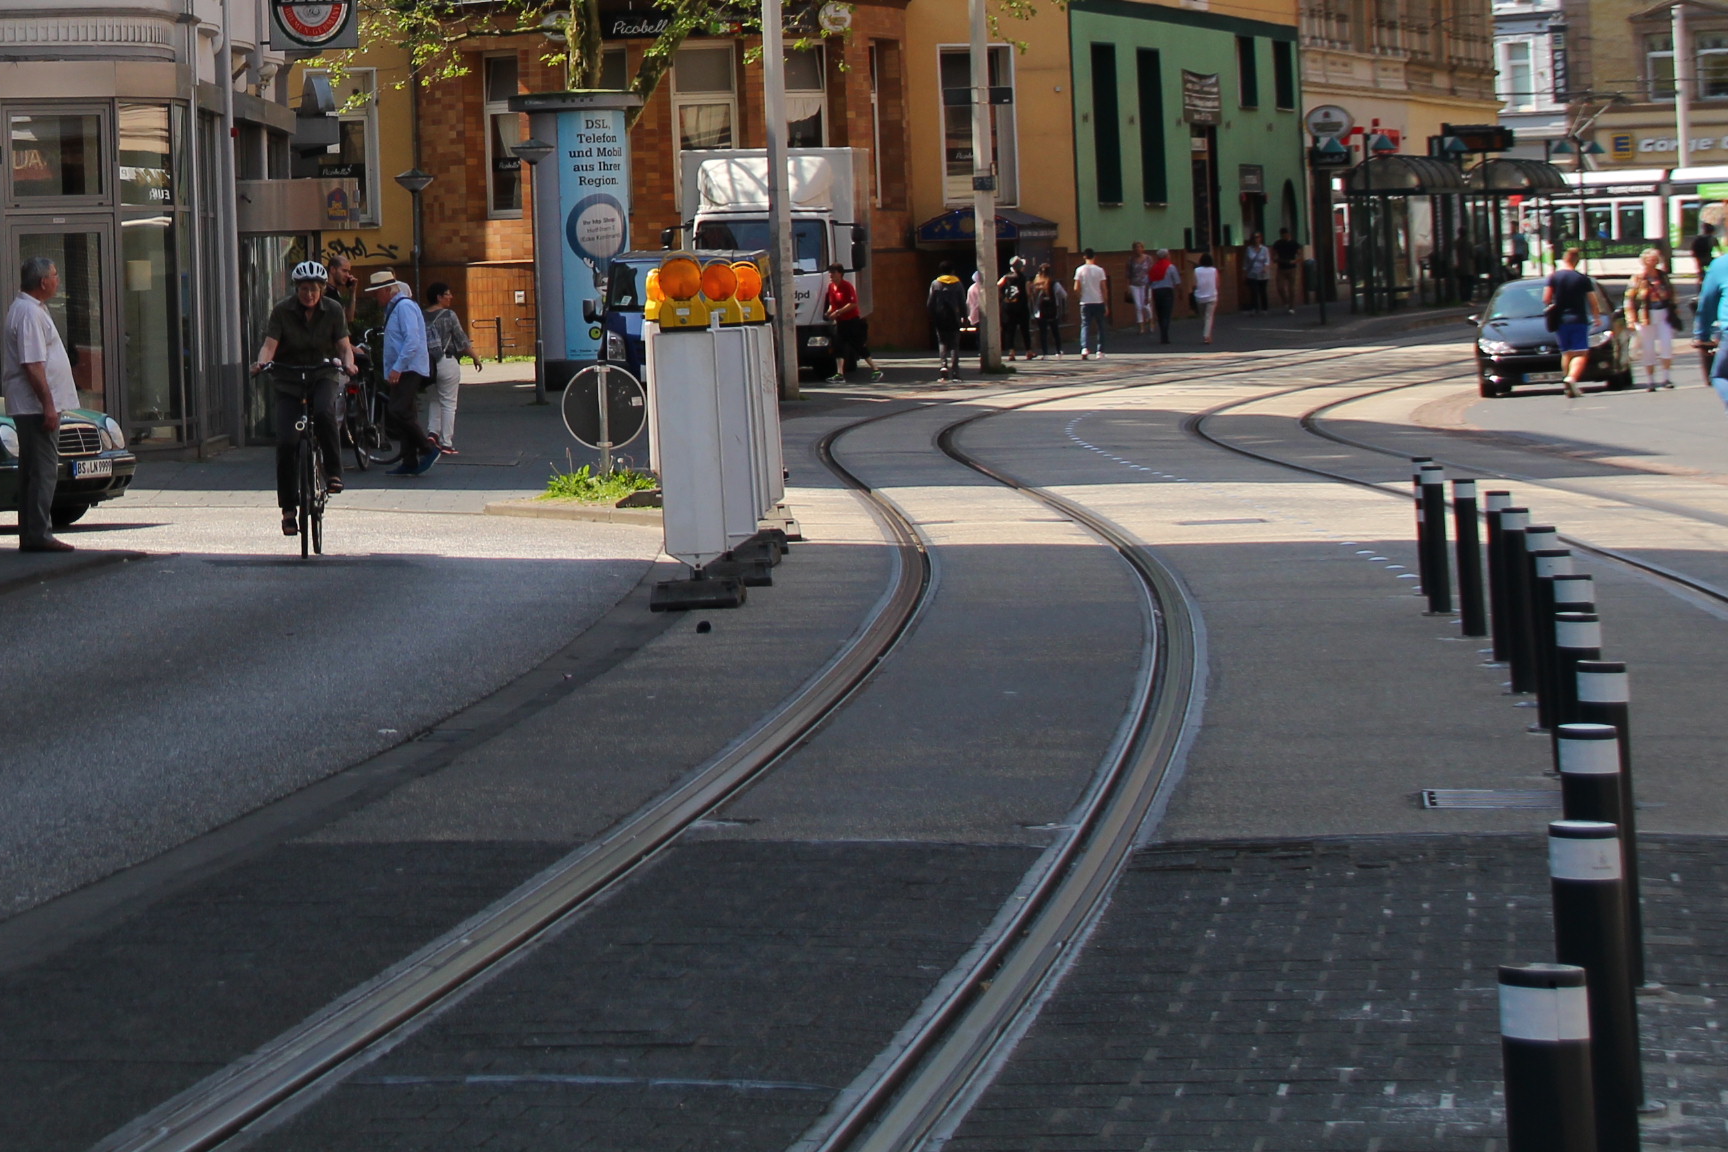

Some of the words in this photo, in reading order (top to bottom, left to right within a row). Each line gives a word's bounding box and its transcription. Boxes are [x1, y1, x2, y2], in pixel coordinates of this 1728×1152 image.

[612, 19, 669, 35] Picobell
[585, 119, 611, 130] DSL,
[576, 133, 617, 144] Telefon
[568, 147, 593, 158] und
[596, 147, 622, 157] Mobil
[573, 163, 595, 172] aus
[598, 161, 621, 171] Ihrer
[578, 175, 619, 188] Region.
